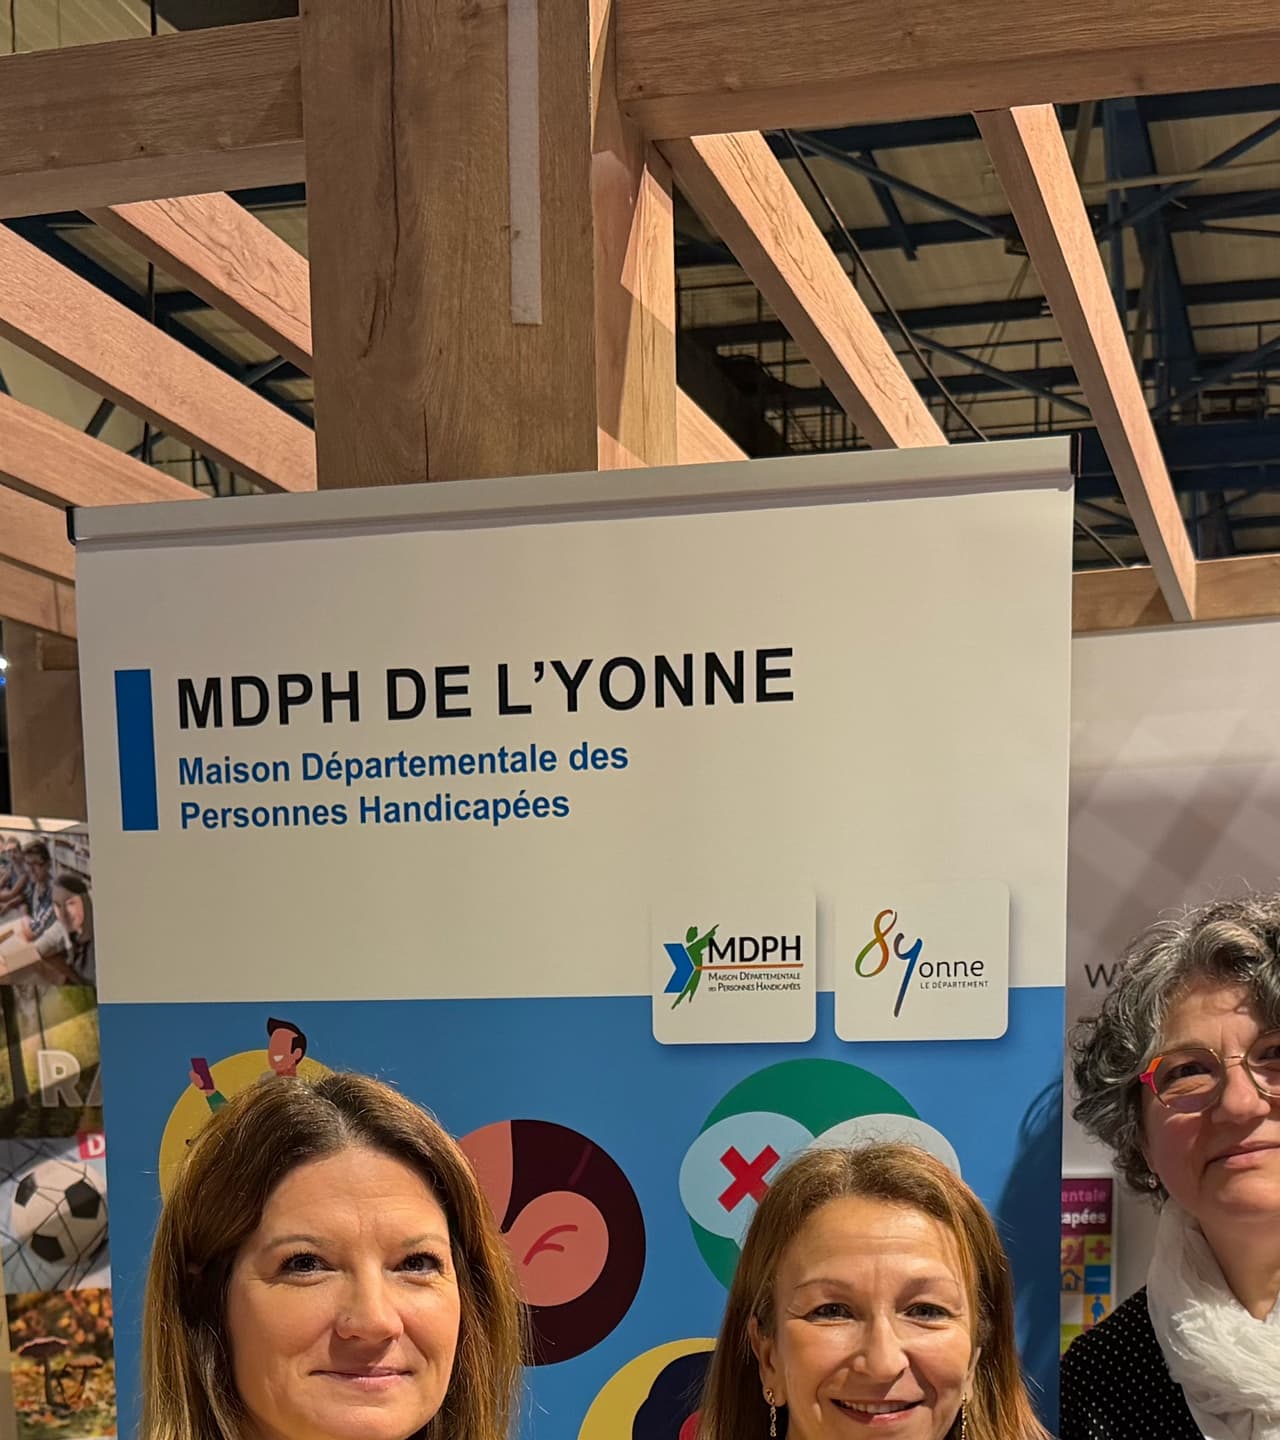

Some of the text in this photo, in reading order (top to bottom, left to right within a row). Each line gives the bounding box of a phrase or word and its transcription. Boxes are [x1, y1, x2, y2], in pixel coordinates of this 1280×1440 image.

[177, 647, 794, 729] MDPH DE L'YONNE
[178, 741, 629, 785] Maison Départementale des
[180, 789, 570, 830] Personnes Handicapées
[708, 935, 801, 963] MDPH
[1061, 1208, 1107, 1229] apées
